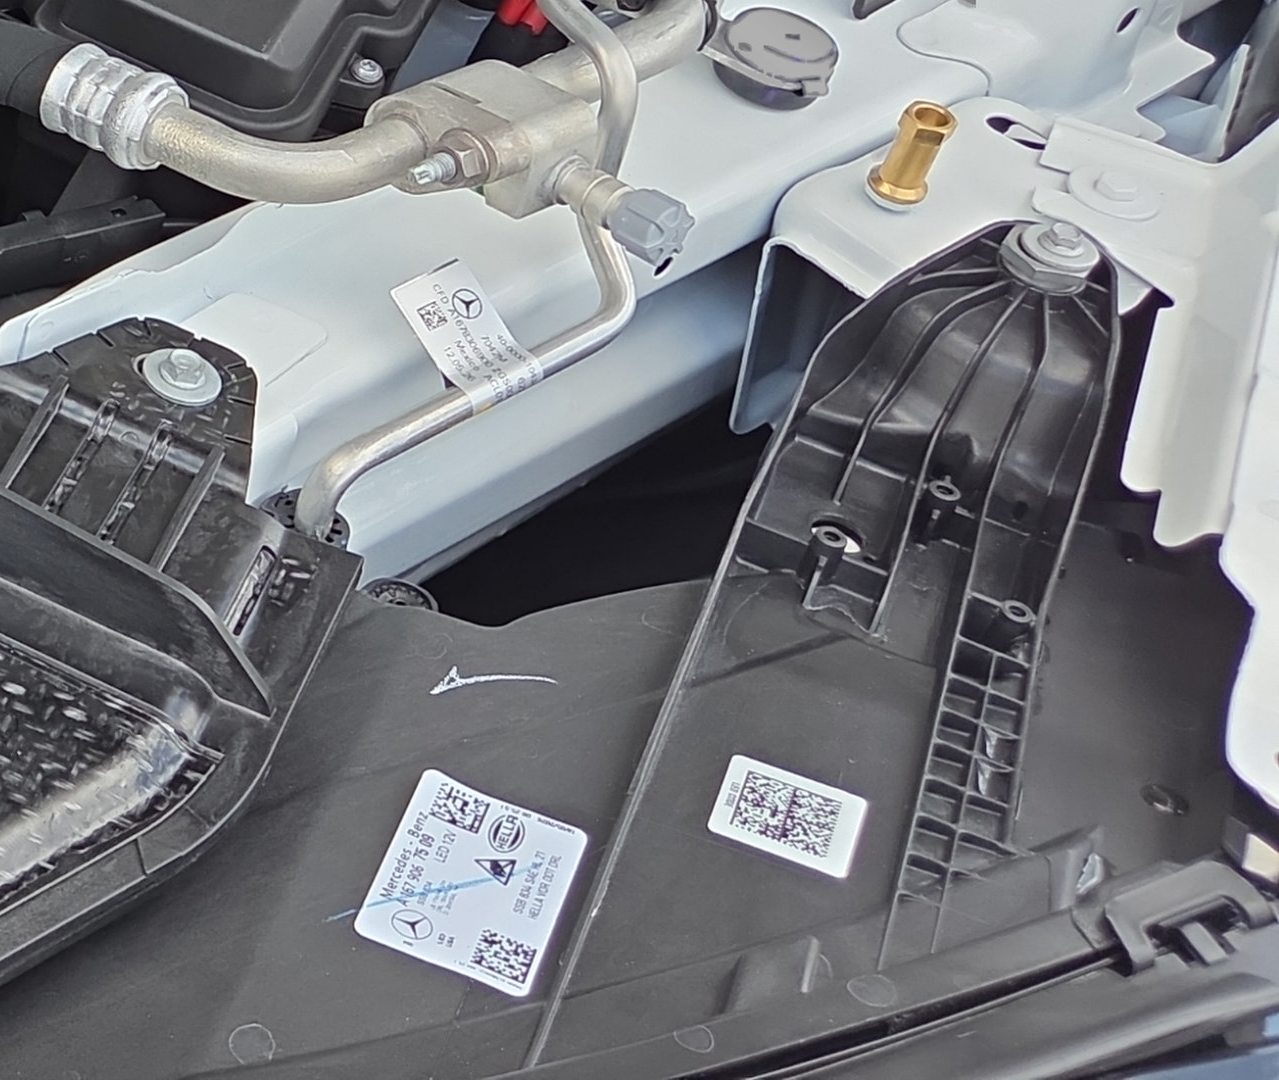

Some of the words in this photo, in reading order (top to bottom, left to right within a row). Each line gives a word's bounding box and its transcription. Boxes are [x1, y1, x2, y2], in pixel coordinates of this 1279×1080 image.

[433, 283, 449, 304] CFD
[454, 340, 480, 371] Mexico
[420, 833, 435, 848] 09
[497, 816, 518, 850] HELLA
[414, 846, 429, 861] 75
[434, 845, 450, 863] LED
[442, 829, 457, 845] 12V
[380, 848, 412, 900] Mercedes
[407, 811, 428, 838] Benz
[408, 864, 423, 882] 906
[524, 868, 539, 885] SAE
[402, 882, 416, 898] 167
[519, 884, 533, 898] 834
[529, 897, 544, 920] HELLA
[541, 866, 555, 882] DOT
[548, 853, 562, 868] DRL
[397, 898, 409, 907] A
[513, 898, 526, 914] SSB
